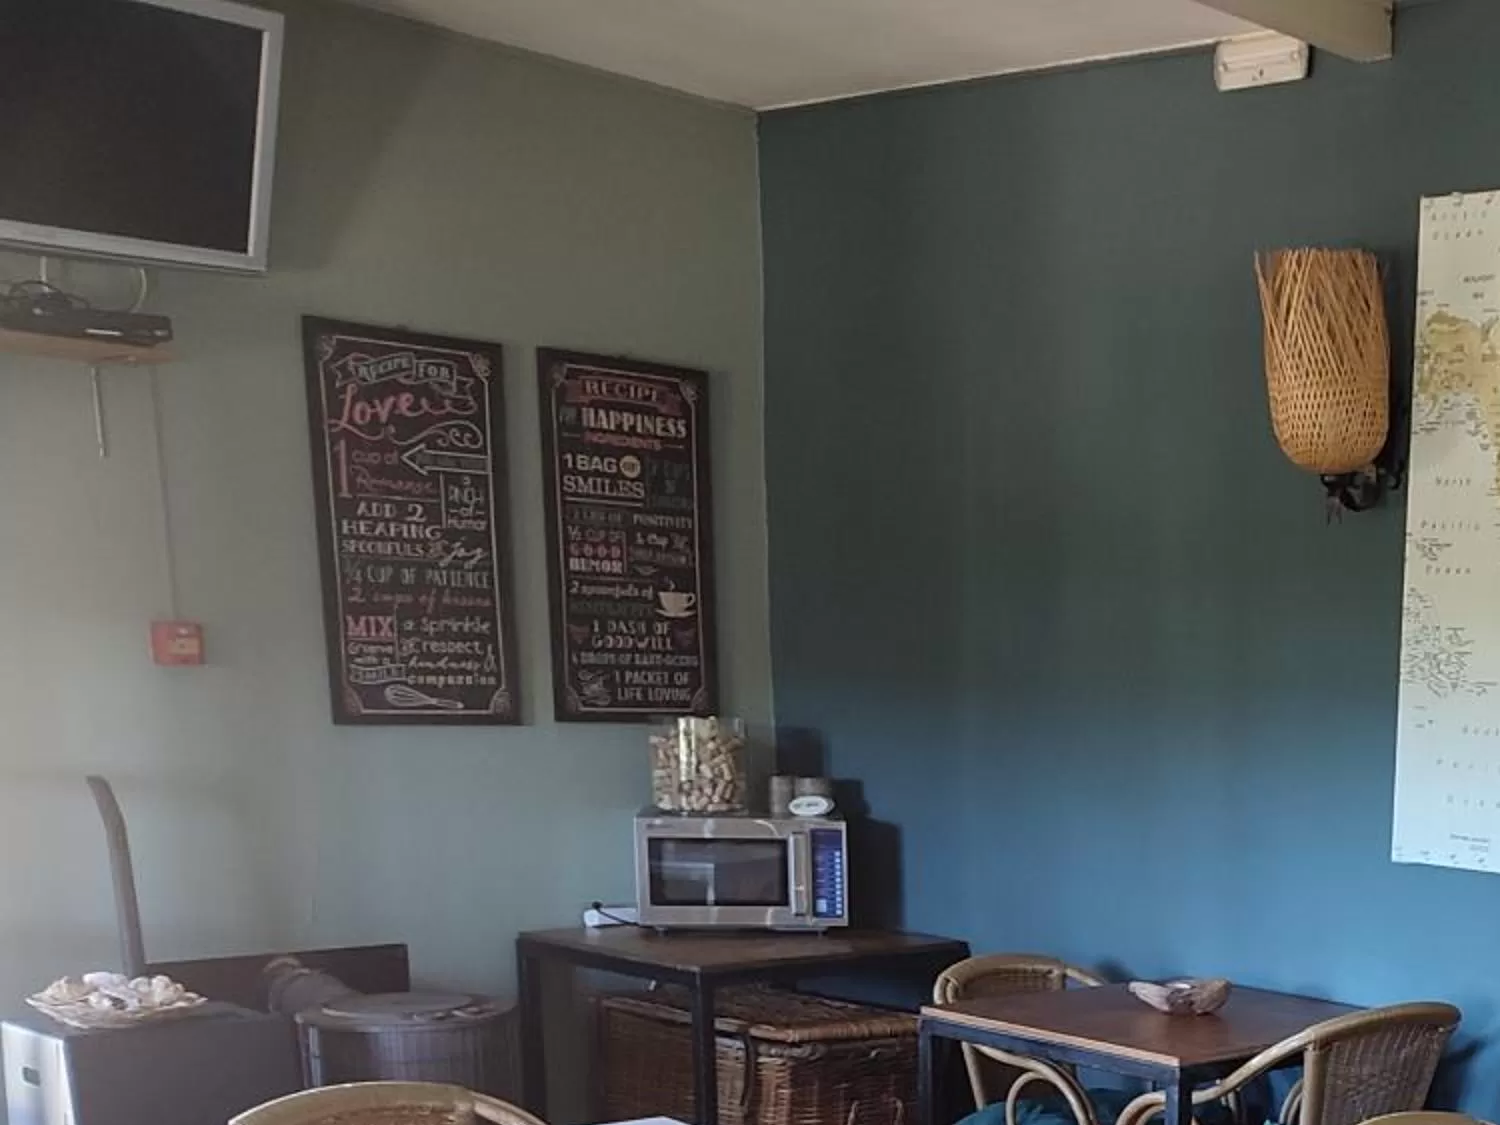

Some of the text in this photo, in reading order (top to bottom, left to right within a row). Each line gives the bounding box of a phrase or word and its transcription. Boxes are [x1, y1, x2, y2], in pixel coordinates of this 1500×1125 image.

[417, 362, 450, 380] FOR
[581, 406, 688, 439] HAPPINESS
[563, 452, 574, 470] 1
[575, 454, 618, 474] BAG
[562, 474, 646, 499] SMILES
[356, 500, 428, 523] ADD 2
[341, 519, 443, 541] HEAPING
[345, 615, 394, 637] MIX
[591, 635, 673, 651] GOODWILL
[673, 671, 691, 686] OF
